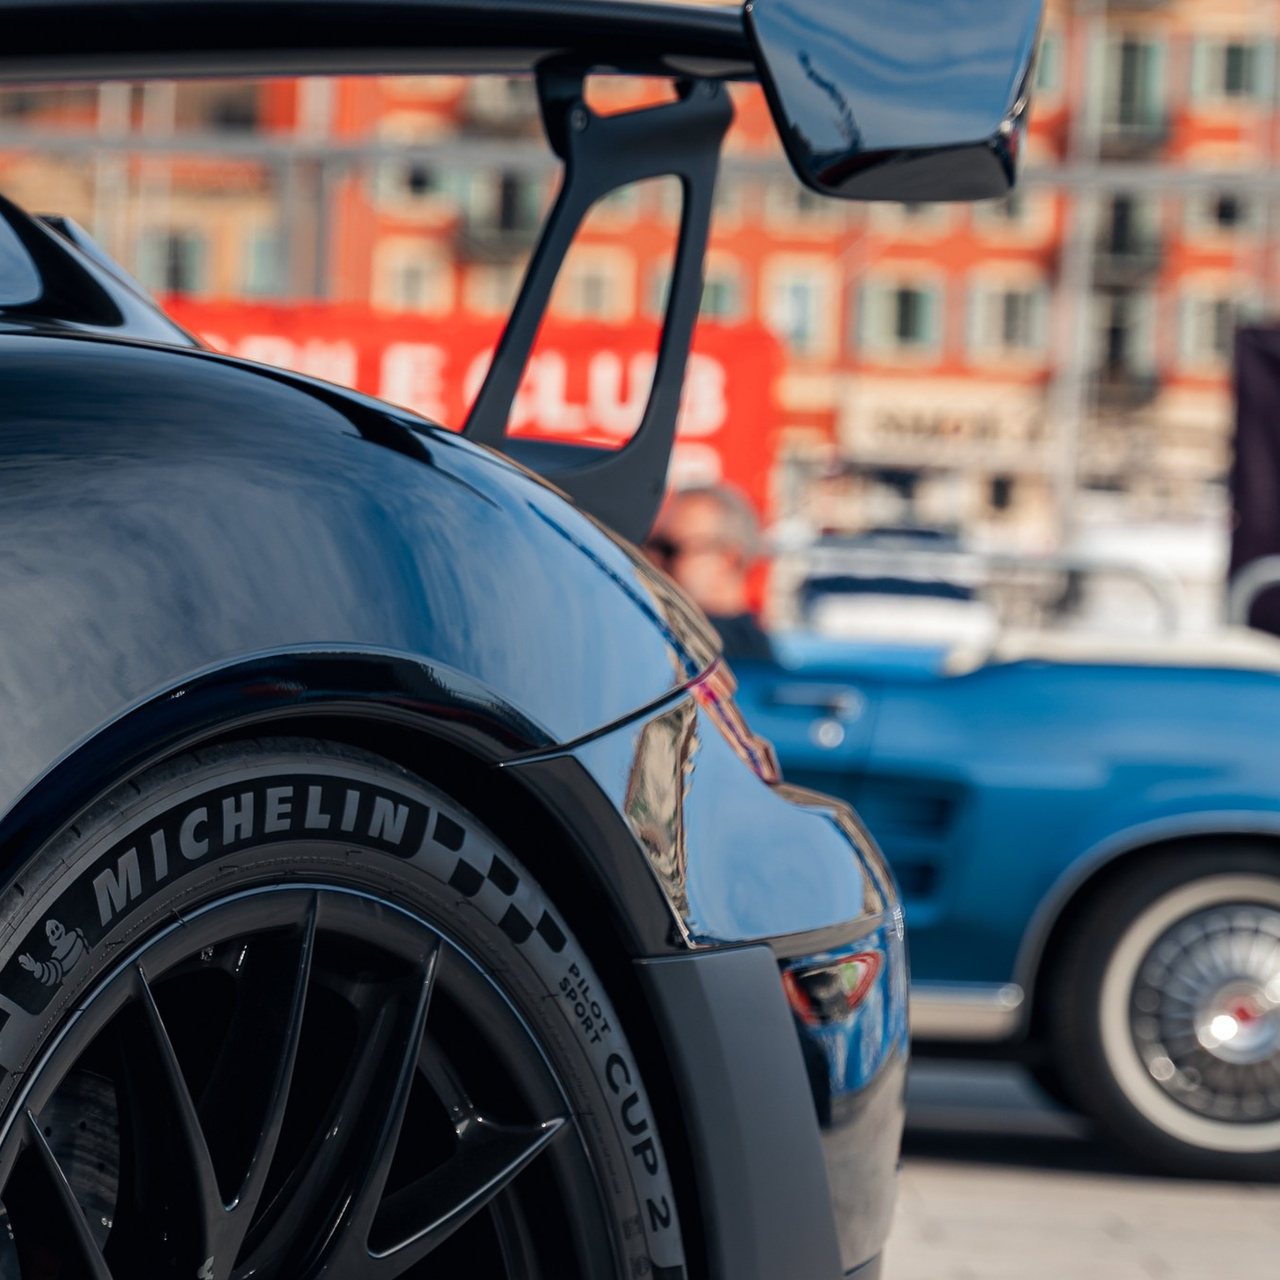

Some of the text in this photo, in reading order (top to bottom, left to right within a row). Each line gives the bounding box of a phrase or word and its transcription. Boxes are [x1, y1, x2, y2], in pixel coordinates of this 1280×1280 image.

[92, 786, 410, 927] MICHELIN
[557, 975, 603, 1046] SPORT
[567, 961, 612, 1037] PILOT
[603, 1051, 660, 1177] CUP
[647, 1194, 673, 1233] 2
